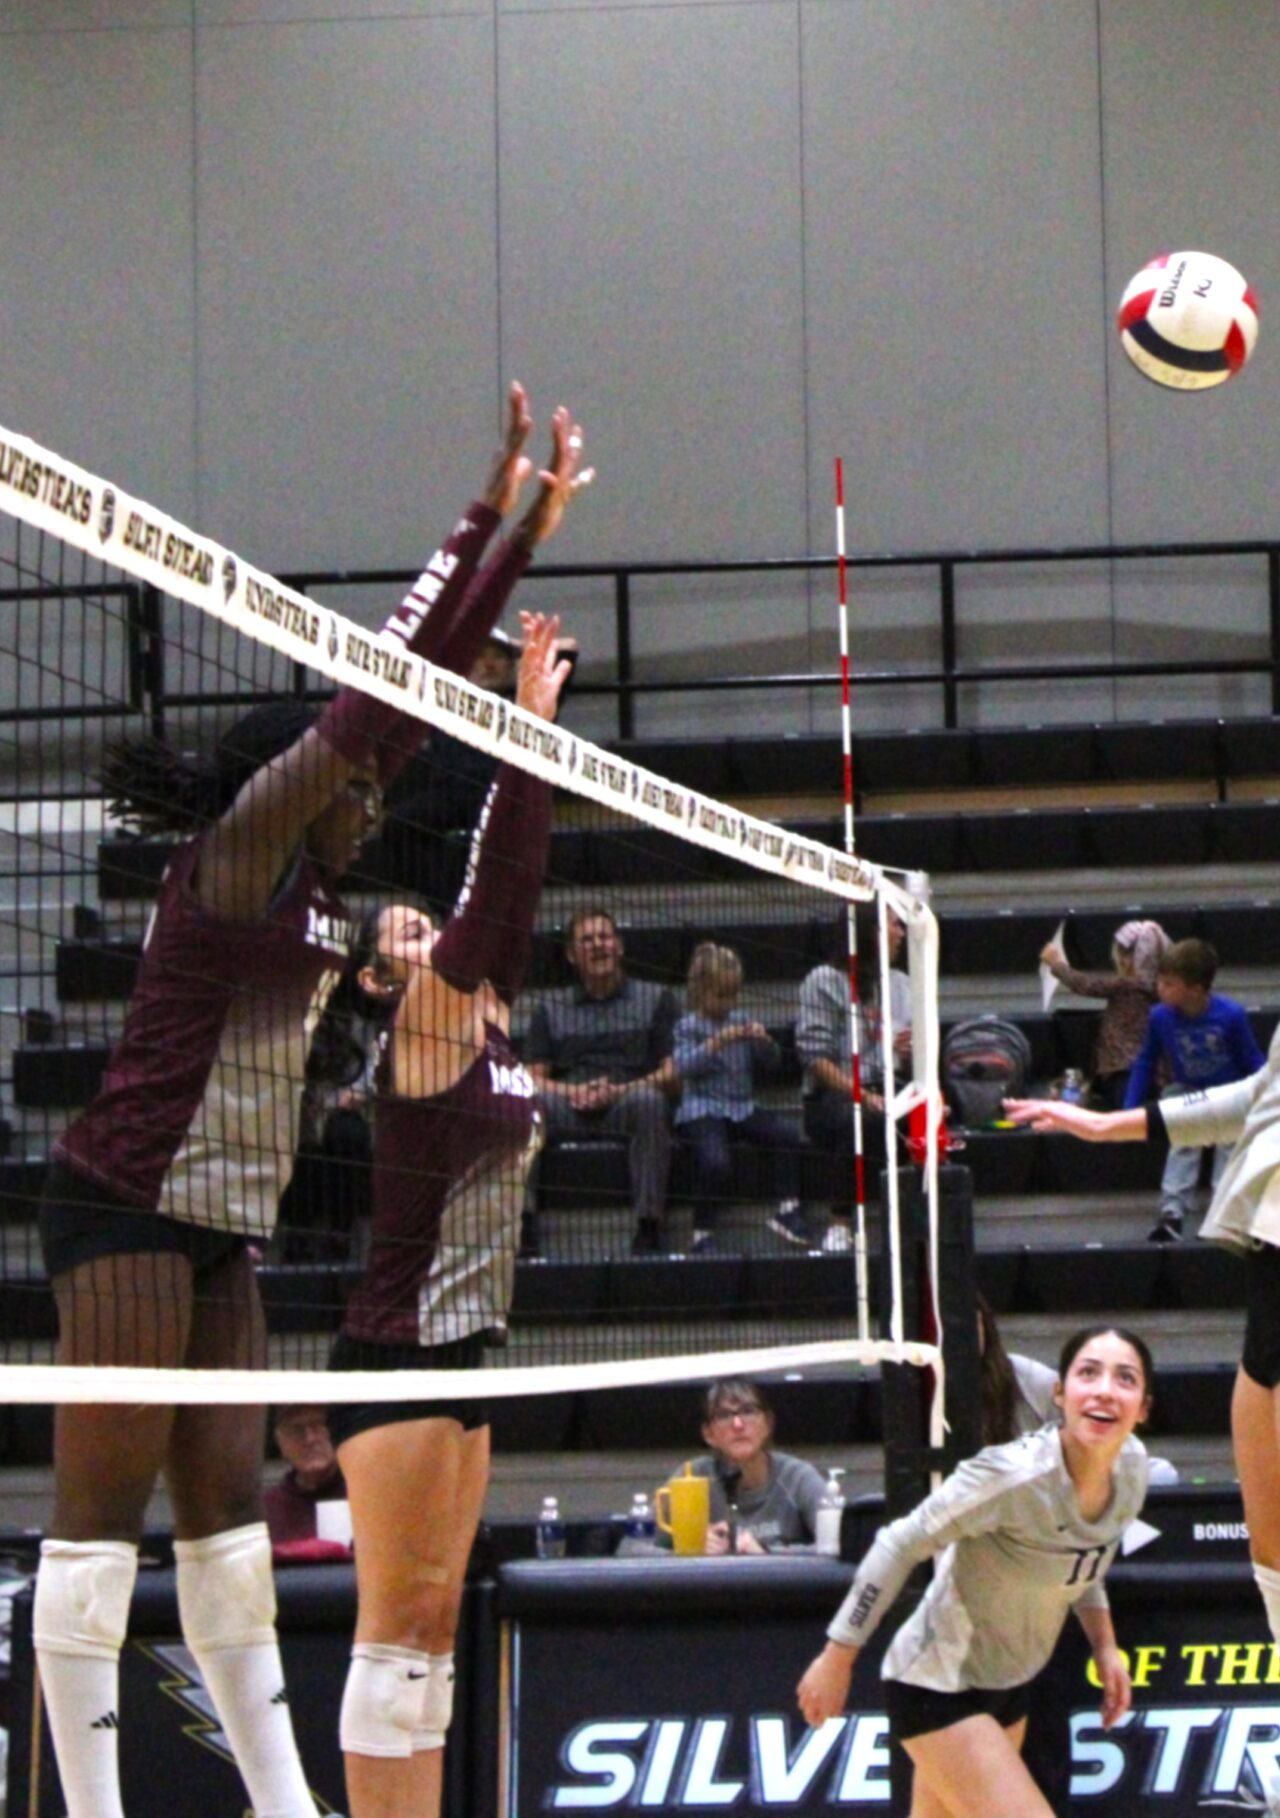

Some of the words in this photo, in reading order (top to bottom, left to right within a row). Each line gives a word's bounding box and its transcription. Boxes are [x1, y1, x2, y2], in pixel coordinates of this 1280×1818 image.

[379, 550, 459, 642] LINE
[1193, 1522, 1250, 1542] BONUS
[1065, 1545, 1108, 1586] 11
[550, 1714, 891, 1807] SILVE
